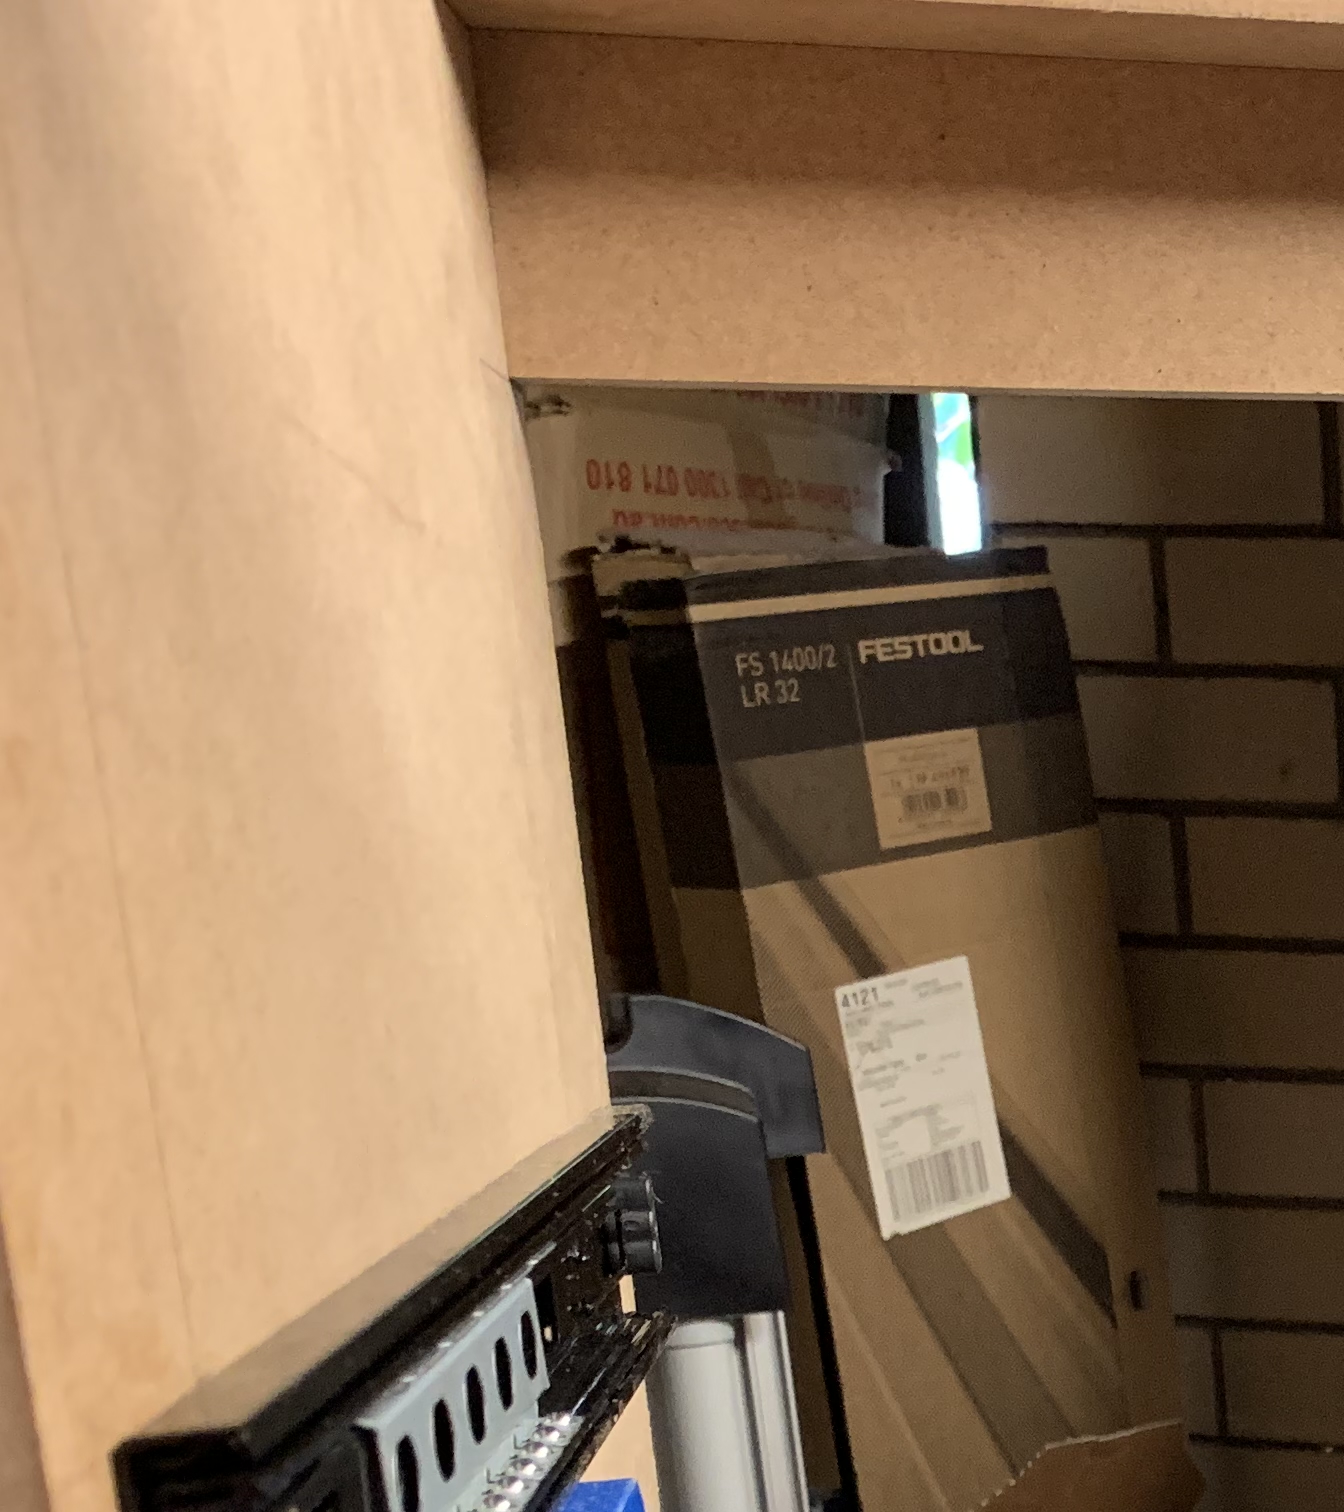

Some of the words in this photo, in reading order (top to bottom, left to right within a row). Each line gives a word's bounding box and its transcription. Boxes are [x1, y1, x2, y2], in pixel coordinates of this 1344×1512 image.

[585, 459, 631, 492] 810
[643, 464, 679, 496] 071
[735, 652, 764, 677] FS
[769, 643, 836, 673] 1400/2
[858, 630, 984, 664] FESTOOL
[740, 682, 770, 707] LR
[774, 678, 801, 704] 32
[841, 987, 879, 1008] 4121
